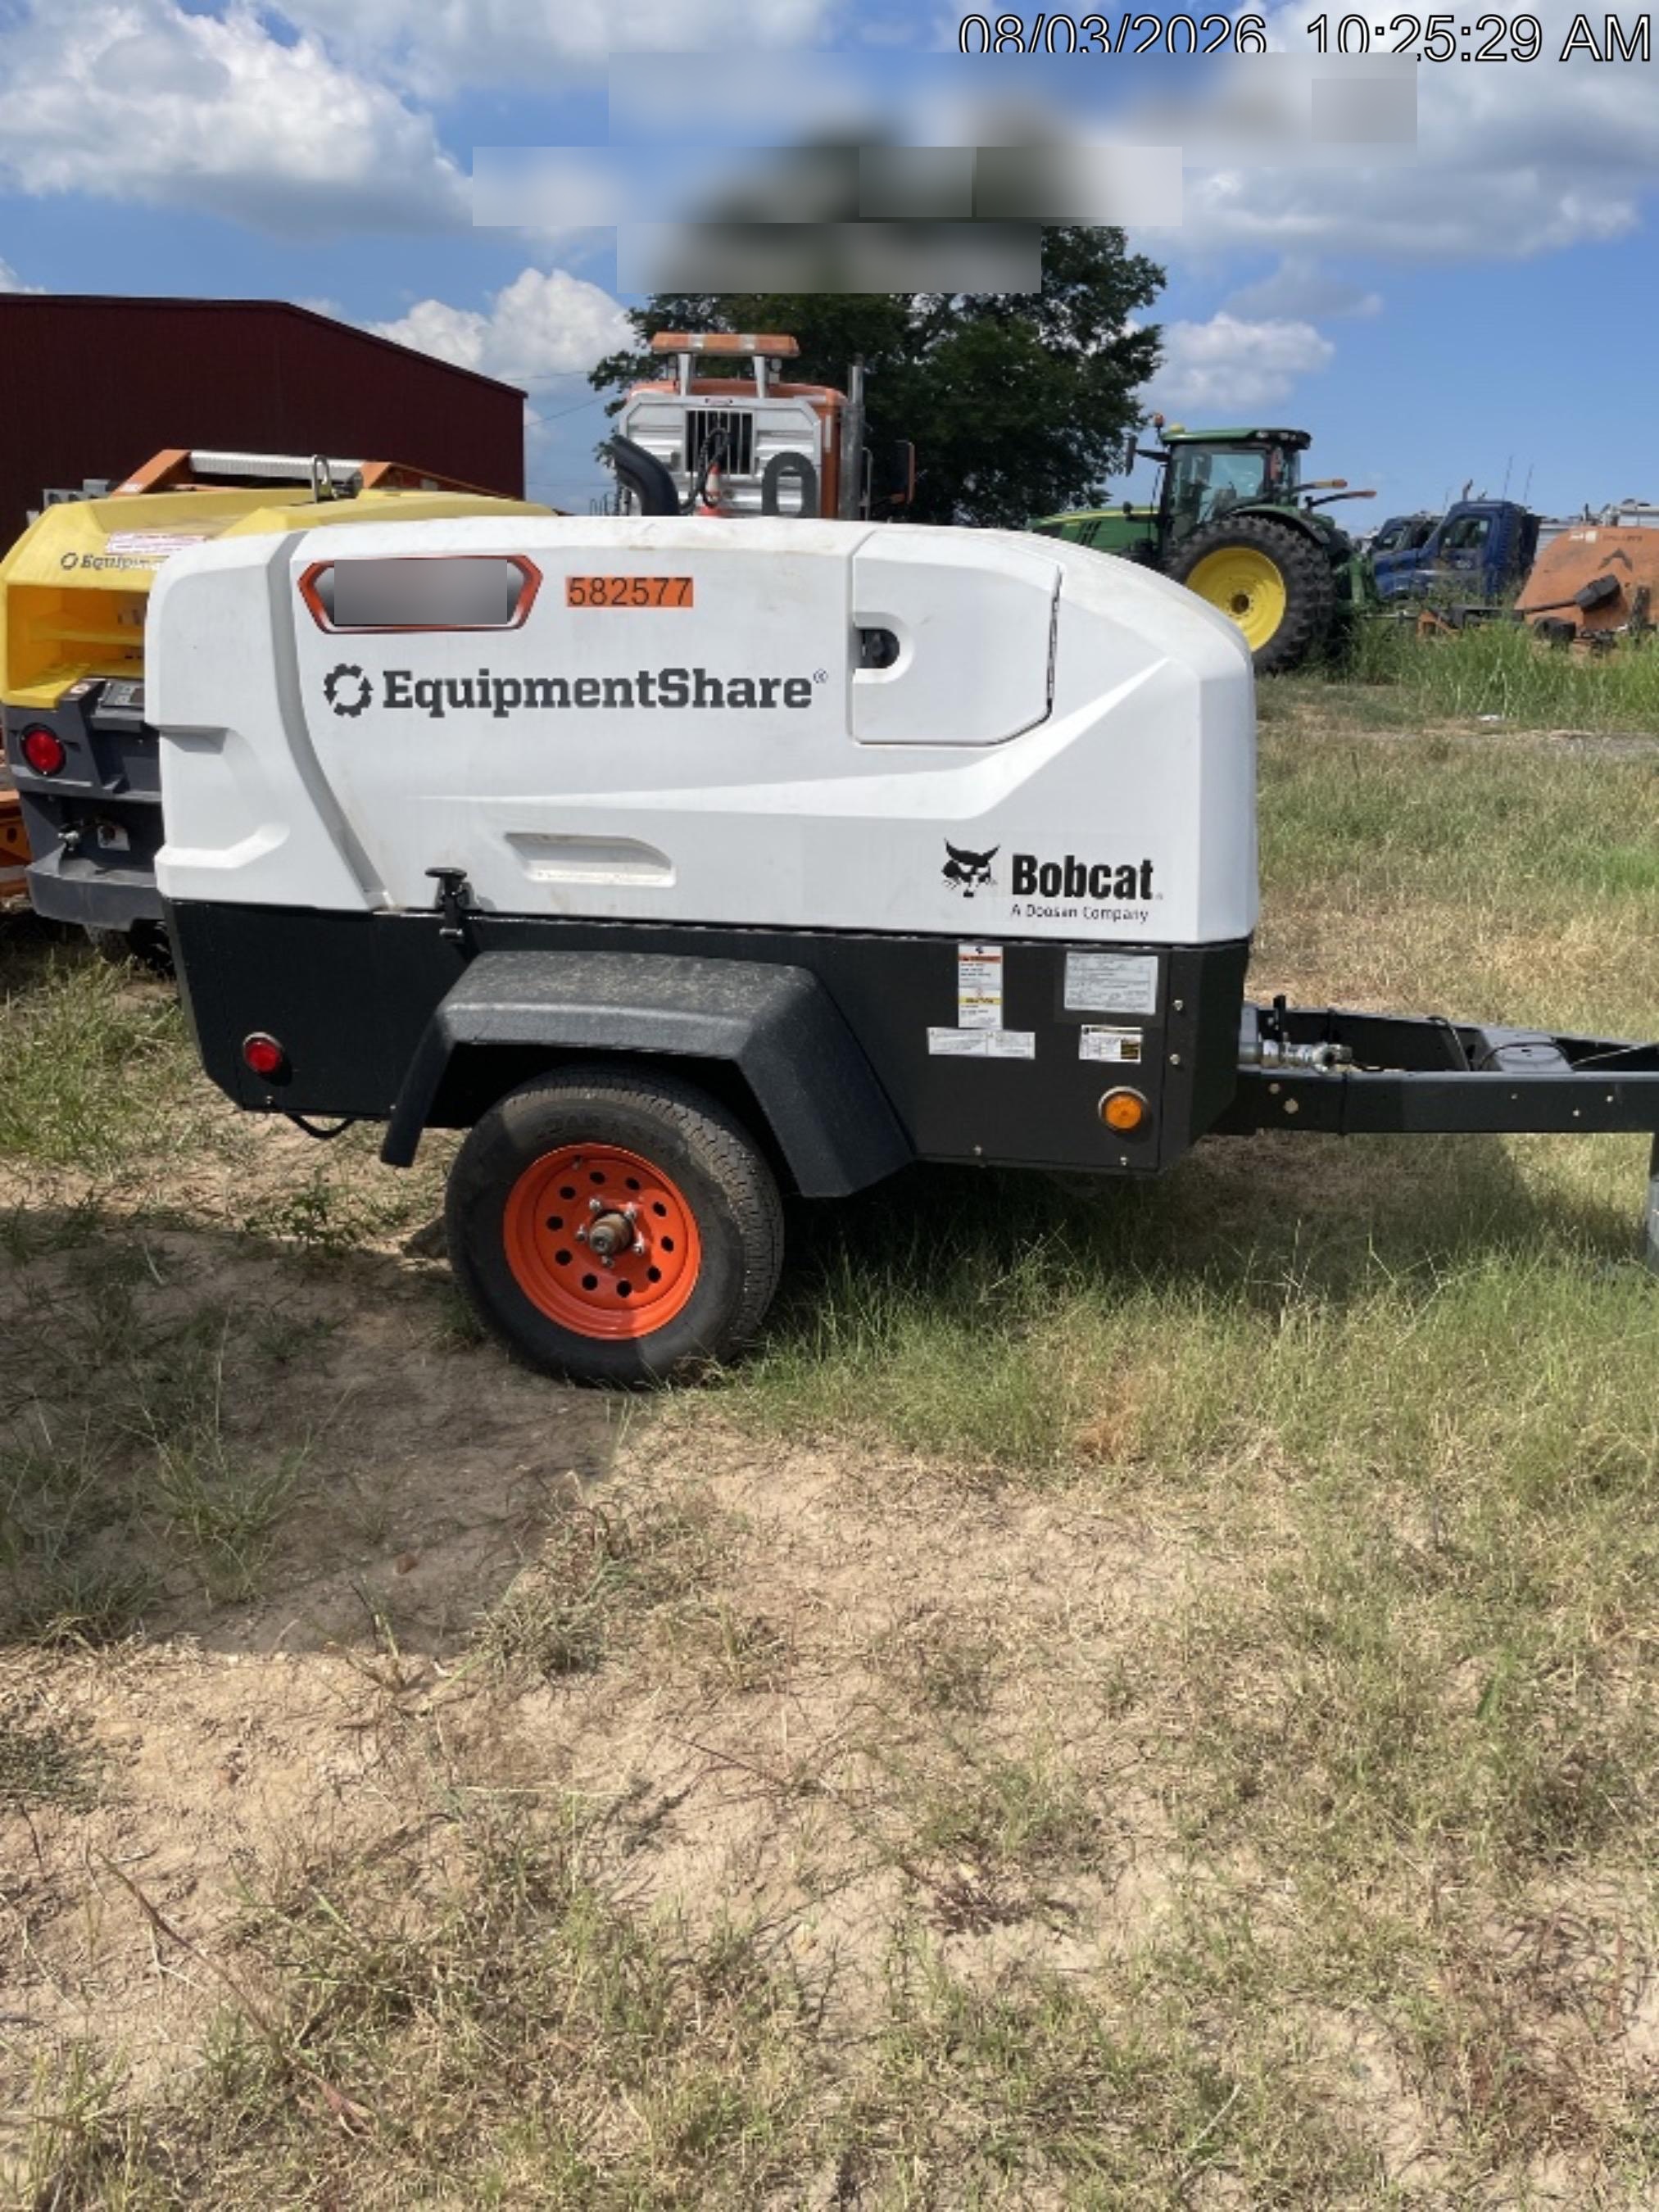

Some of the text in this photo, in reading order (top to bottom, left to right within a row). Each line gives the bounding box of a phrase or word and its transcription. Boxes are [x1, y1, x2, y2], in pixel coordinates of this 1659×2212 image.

[569, 577, 692, 605] 582577
[1013, 854, 1154, 900] Bobcat
[1010, 904, 1149, 924] A Doosan Company
